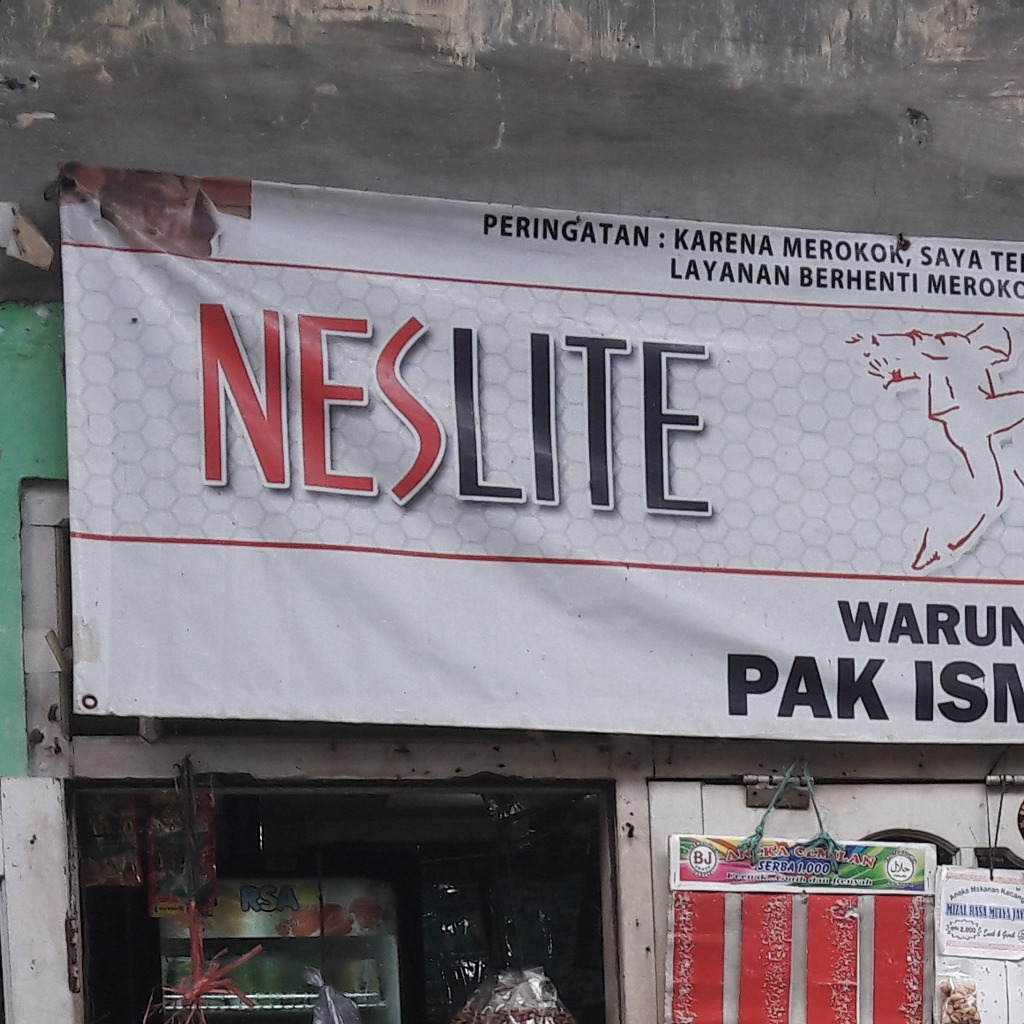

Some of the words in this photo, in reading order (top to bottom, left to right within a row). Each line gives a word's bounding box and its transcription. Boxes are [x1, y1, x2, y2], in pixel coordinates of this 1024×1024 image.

[482, 213, 651, 249] PERINGATAN
[658, 231, 666, 249] :
[674, 228, 774, 257] KARENA
[783, 237, 912, 268] MEROKOK,
[920, 246, 984, 271] SAYA
[670, 258, 791, 286] LAYANAN
[799, 265, 918, 293] BERHENTI
[199, 303, 712, 516] NESLITE
[727, 653, 890, 721] PAK
[693, 850, 712, 865] BJ
[756, 859, 796, 874] SERBA
[796, 861, 831, 875] 1.000
[239, 884, 300, 913] RSA
